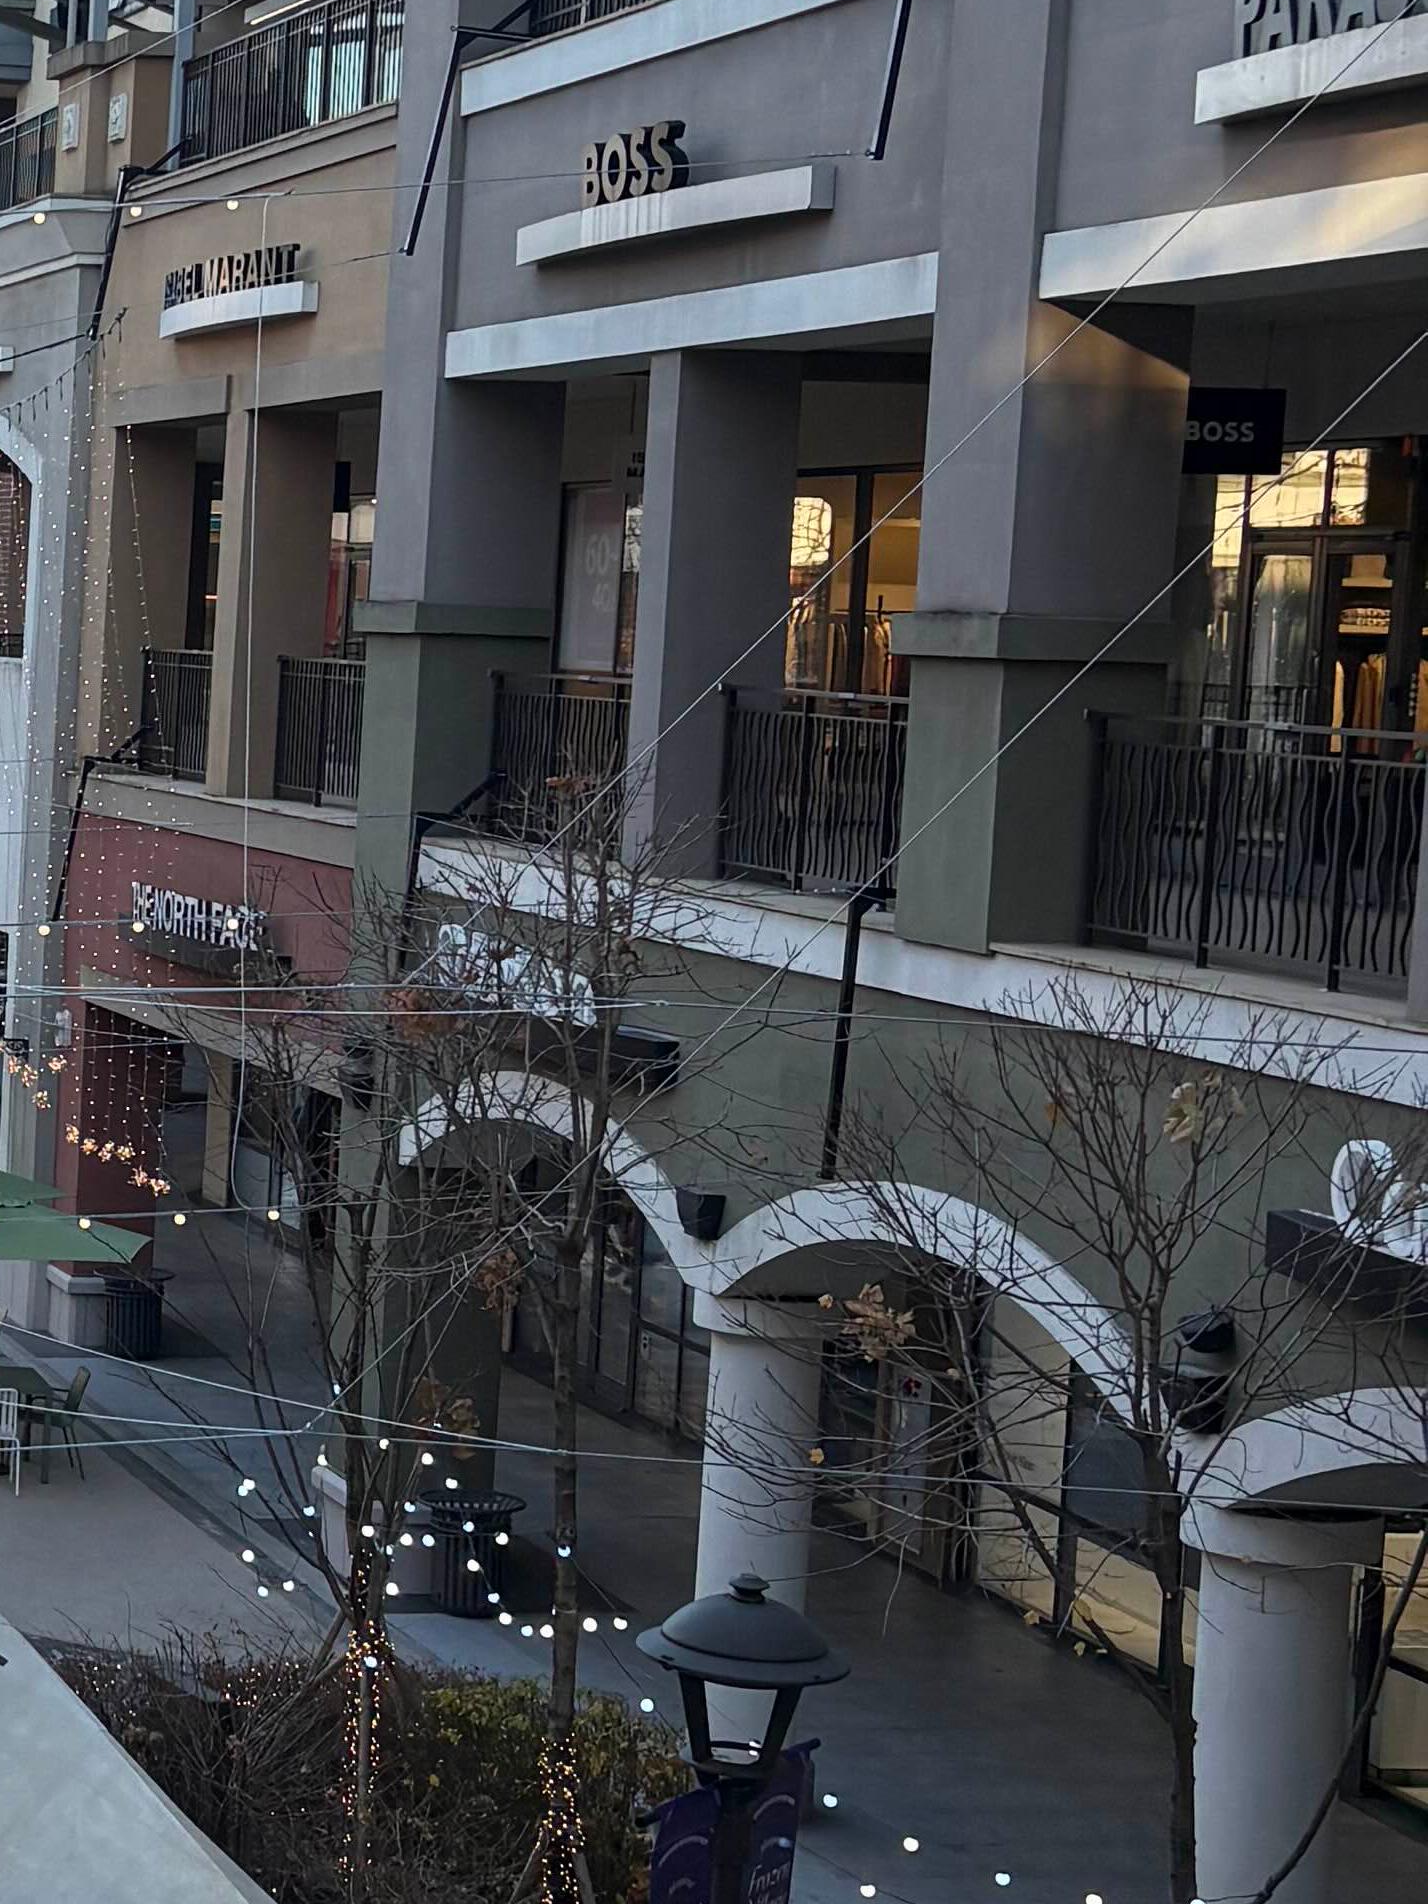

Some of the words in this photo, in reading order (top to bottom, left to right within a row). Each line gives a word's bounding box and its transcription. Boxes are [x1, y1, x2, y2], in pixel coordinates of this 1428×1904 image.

[581, 120, 690, 208] BOSS
[204, 243, 300, 298] MARANT
[1186, 420, 1255, 443] BOSS
[152, 888, 207, 942] NORTH
